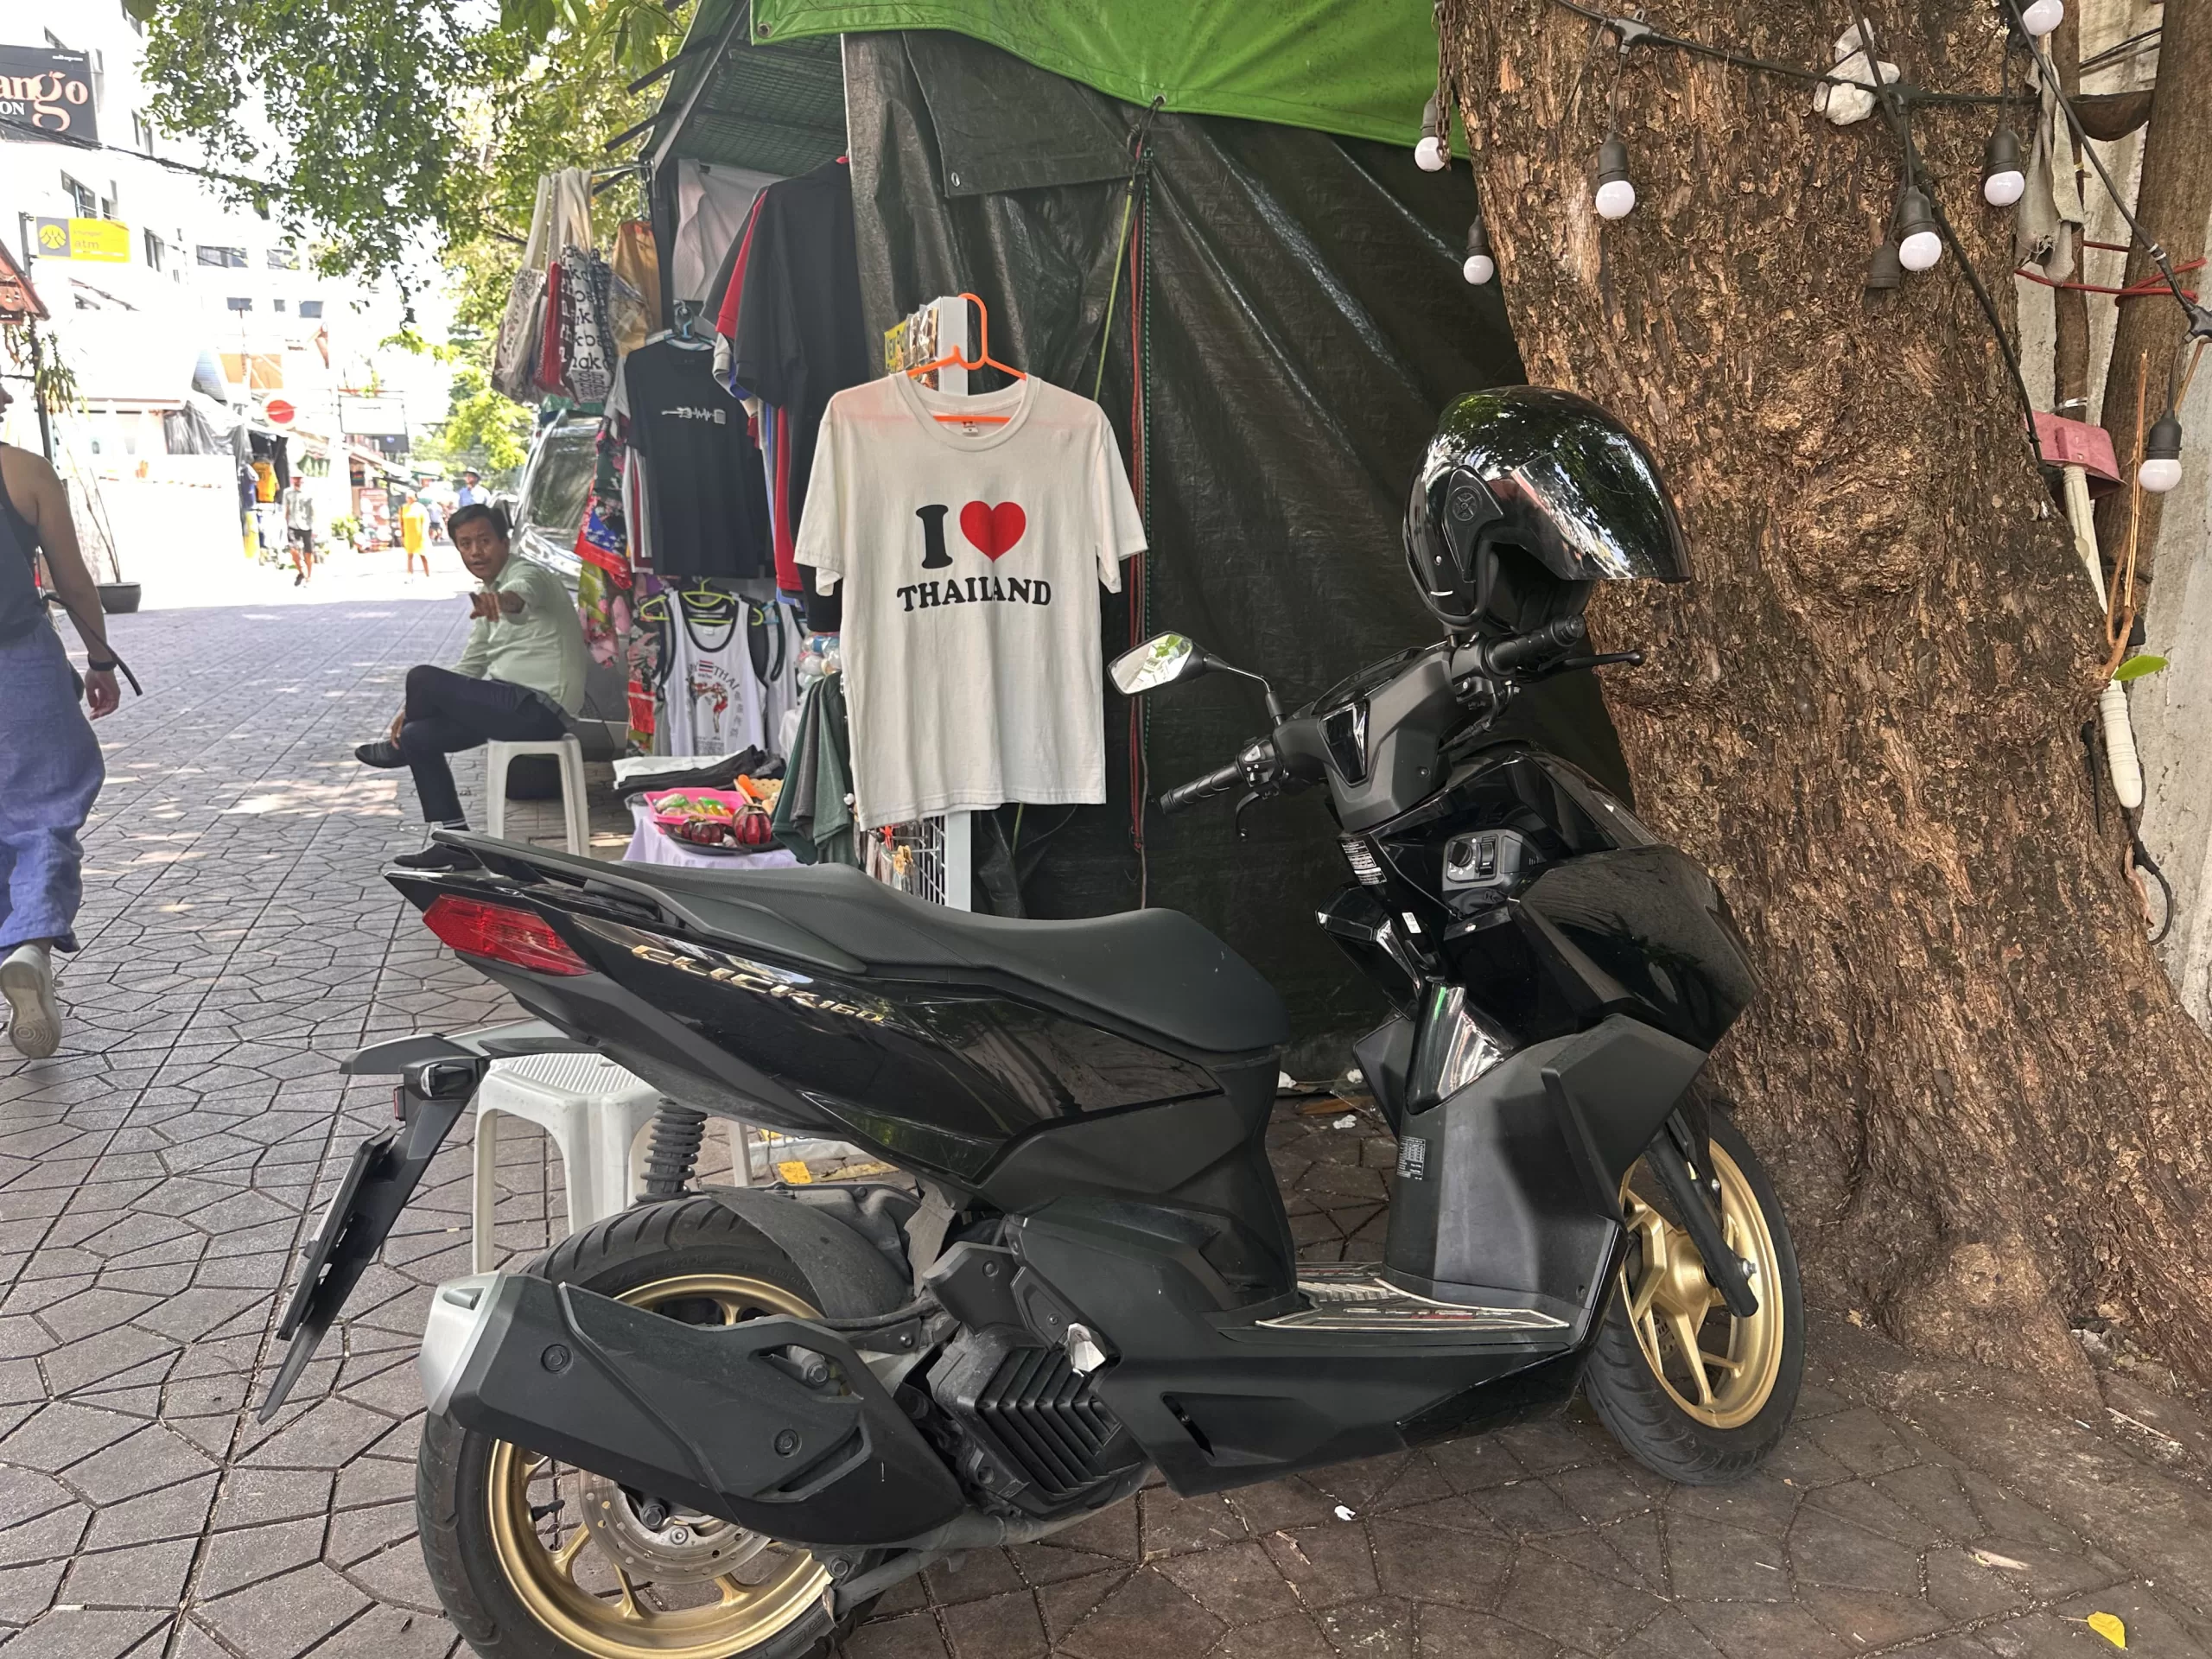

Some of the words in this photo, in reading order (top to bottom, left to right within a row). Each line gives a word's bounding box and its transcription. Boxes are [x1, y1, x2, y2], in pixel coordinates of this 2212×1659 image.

[74, 239, 99, 250] atm
[916, 504, 953, 569] I
[896, 575, 1052, 612] THAILAND
[713, 664, 741, 690] THAI
